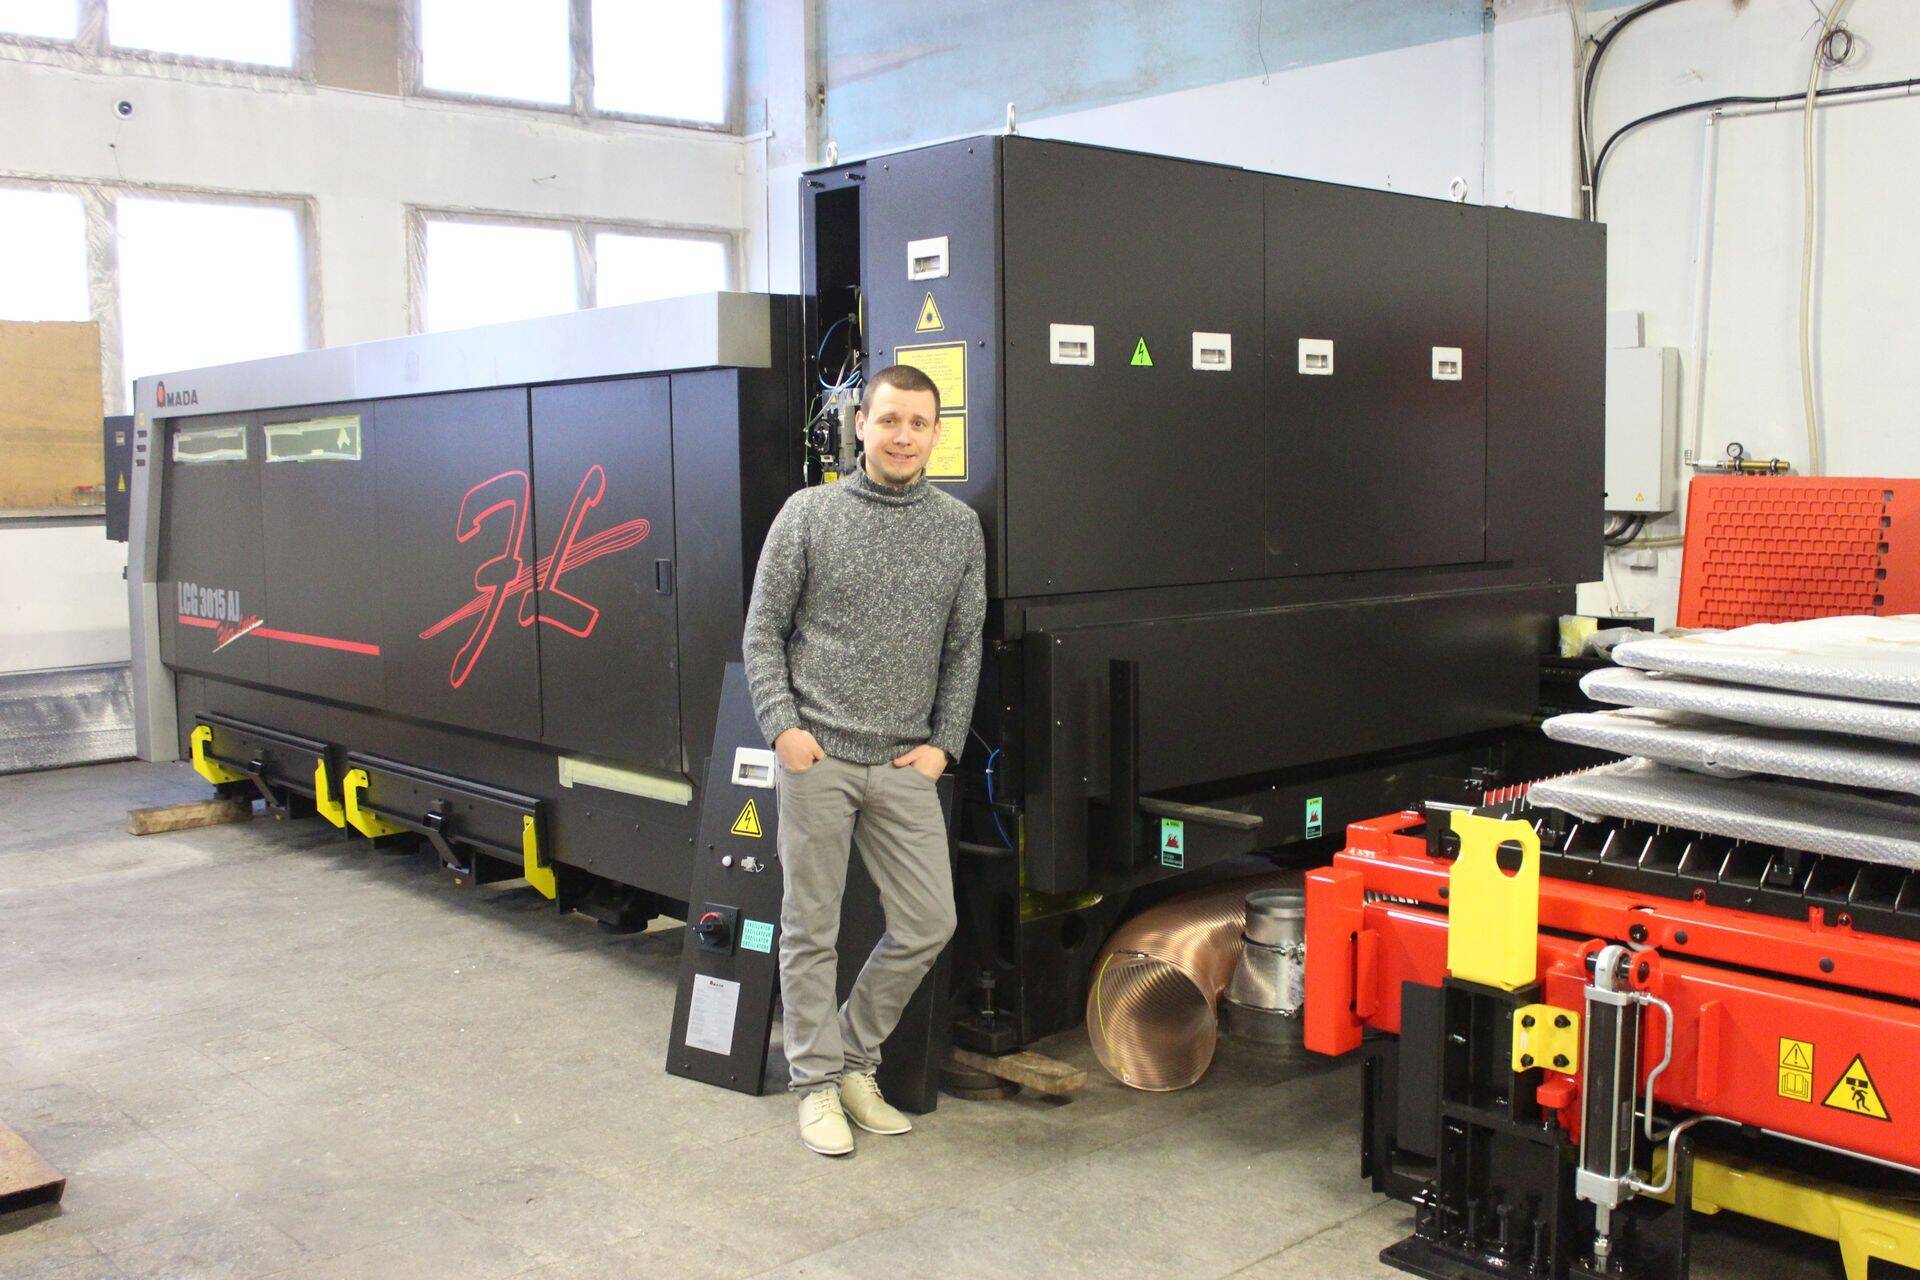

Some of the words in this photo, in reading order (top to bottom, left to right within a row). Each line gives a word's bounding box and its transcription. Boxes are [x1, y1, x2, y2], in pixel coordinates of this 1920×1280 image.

[156, 380, 199, 408] AMADA
[177, 581, 198, 616] LCG
[199, 587, 226, 620] 3015
